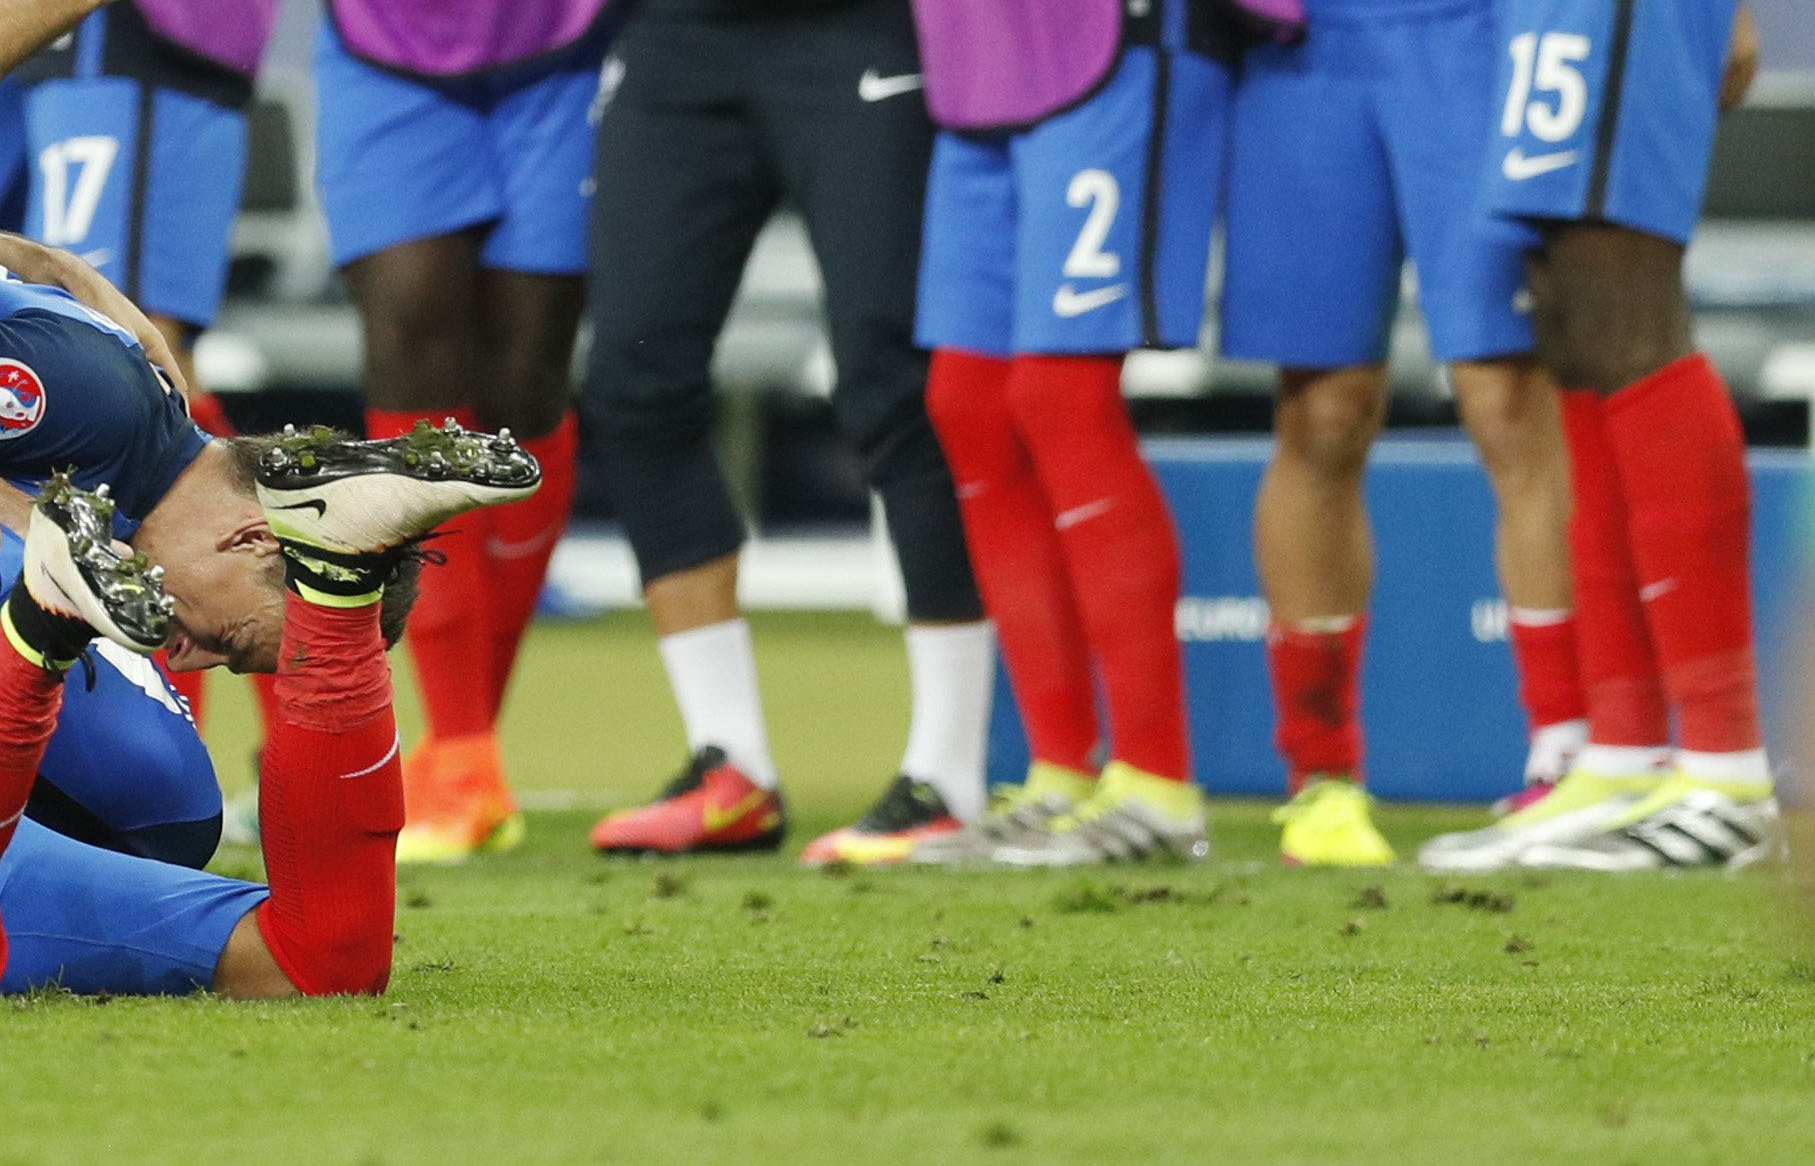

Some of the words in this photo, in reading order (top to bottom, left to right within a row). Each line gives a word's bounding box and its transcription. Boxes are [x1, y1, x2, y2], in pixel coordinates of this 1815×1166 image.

[1499, 31, 1591, 143] 15
[39, 134, 120, 246] 17
[1062, 168, 1120, 278] 2
